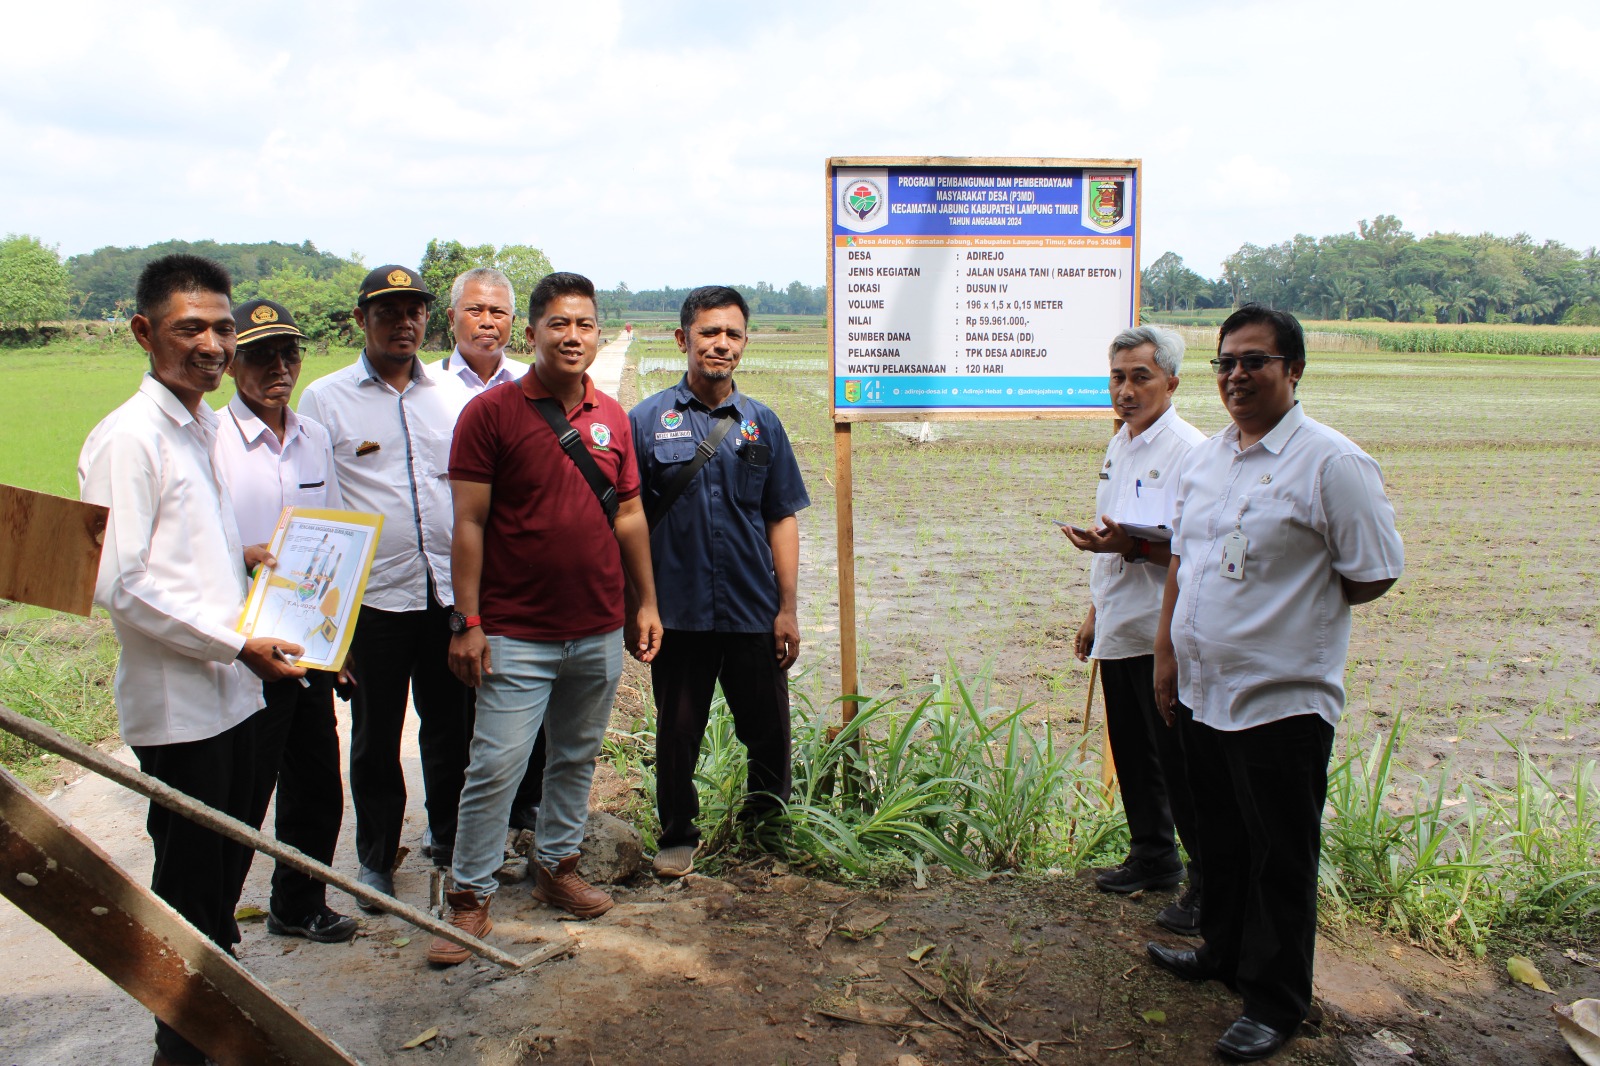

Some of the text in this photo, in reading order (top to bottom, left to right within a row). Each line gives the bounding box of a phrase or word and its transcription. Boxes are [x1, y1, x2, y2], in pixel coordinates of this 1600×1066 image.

[898, 176, 1073, 188] PROGRAM PEMBANGUNAN DAN PEMBERDAYAAN
[936, 190, 1035, 204] MASYARAKAT DESA (P3MD)
[892, 204, 1079, 214] KECAMATAN JABUNG KABUPATEN LAMPUNG TIMUR
[949, 216, 1022, 226] TAHUN ANGGARAN 2024
[848, 251, 872, 260] DESA
[966, 252, 1004, 260] ADIREJO
[848, 268, 874, 276] JENIS
[876, 268, 920, 276] KEGIATAN
[966, 268, 994, 277] JALAN
[997, 268, 1027, 277] USAHA
[1029, 268, 1049, 277] TANI
[1058, 268, 1086, 278] RABAT
[1088, 268, 1116, 278] BETON
[848, 284, 880, 293] LOKASI
[966, 284, 996, 293] DUSUN
[999, 284, 1008, 293] IV
[848, 300, 884, 309] VOLUME
[966, 300, 981, 309] 196
[991, 300, 1004, 312] 1,5
[1014, 300, 1032, 312] 0,15
[1034, 300, 1063, 310] METER
[848, 316, 872, 325] NILAI
[966, 316, 977, 327] Rp
[979, 316, 1030, 327] 59.961.000,-
[848, 332, 885, 341] SUMBER
[887, 332, 911, 342] DANA
[966, 332, 990, 342] DANA
[992, 332, 1014, 342] DESA
[1016, 332, 1034, 344] (DD)
[848, 348, 900, 358] PELAKSANA
[966, 348, 983, 358] TPK
[985, 348, 1008, 358] DESA
[1010, 348, 1047, 358] ADIREJO
[848, 364, 880, 374] WAKTU
[882, 364, 946, 374] PELAKSANAAN
[966, 364, 981, 374] 120
[983, 364, 1004, 374] HARI
